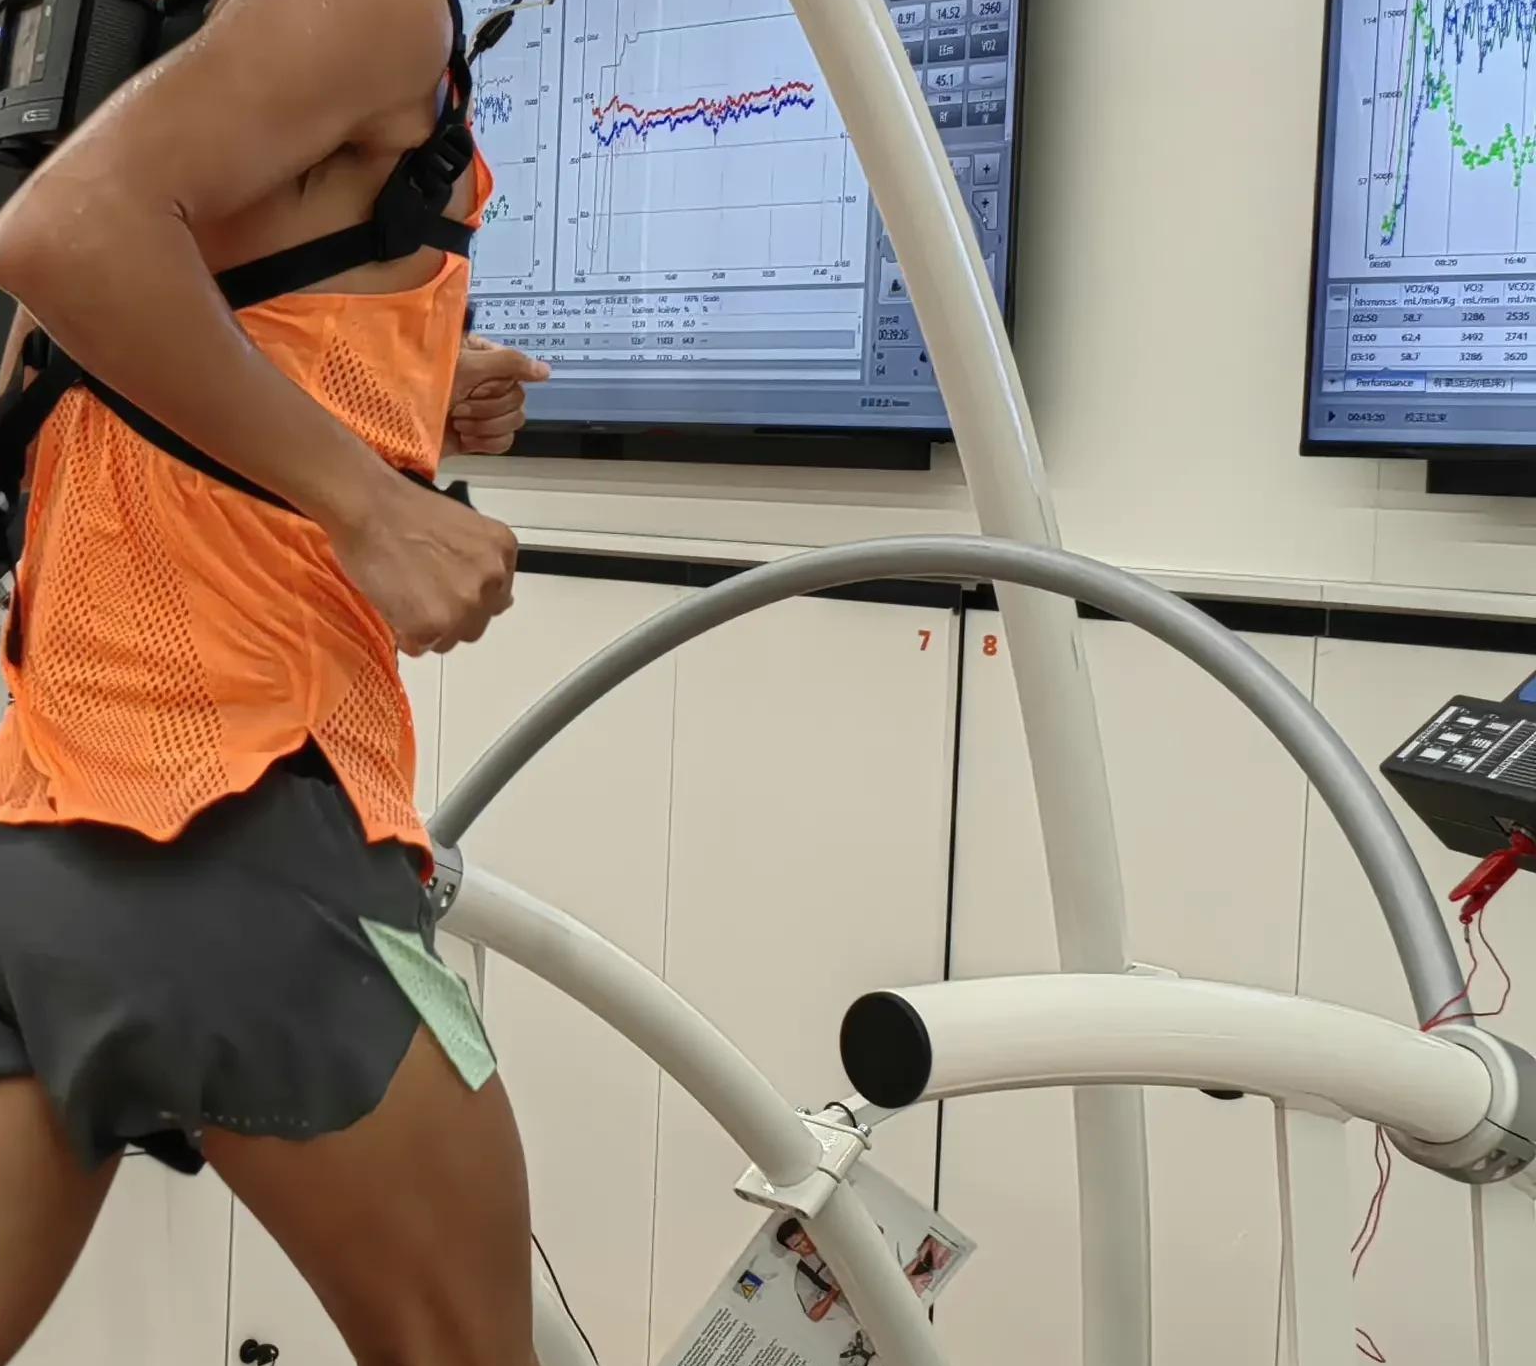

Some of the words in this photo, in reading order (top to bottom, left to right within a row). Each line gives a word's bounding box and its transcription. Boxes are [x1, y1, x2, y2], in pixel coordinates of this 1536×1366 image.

[937, 6, 961, 20] 14.52
[979, 1, 1002, 16] 2960
[897, 11, 916, 25] 0.91
[981, 39, 996, 52] VO2
[935, 73, 954, 86] 45.1
[1404, 284, 1440, 295] VO2/Kg
[1464, 283, 1484, 293] VO2
[1356, 378, 1414, 388] Performance
[918, 630, 931, 651] 7
[983, 634, 997, 656] 8
